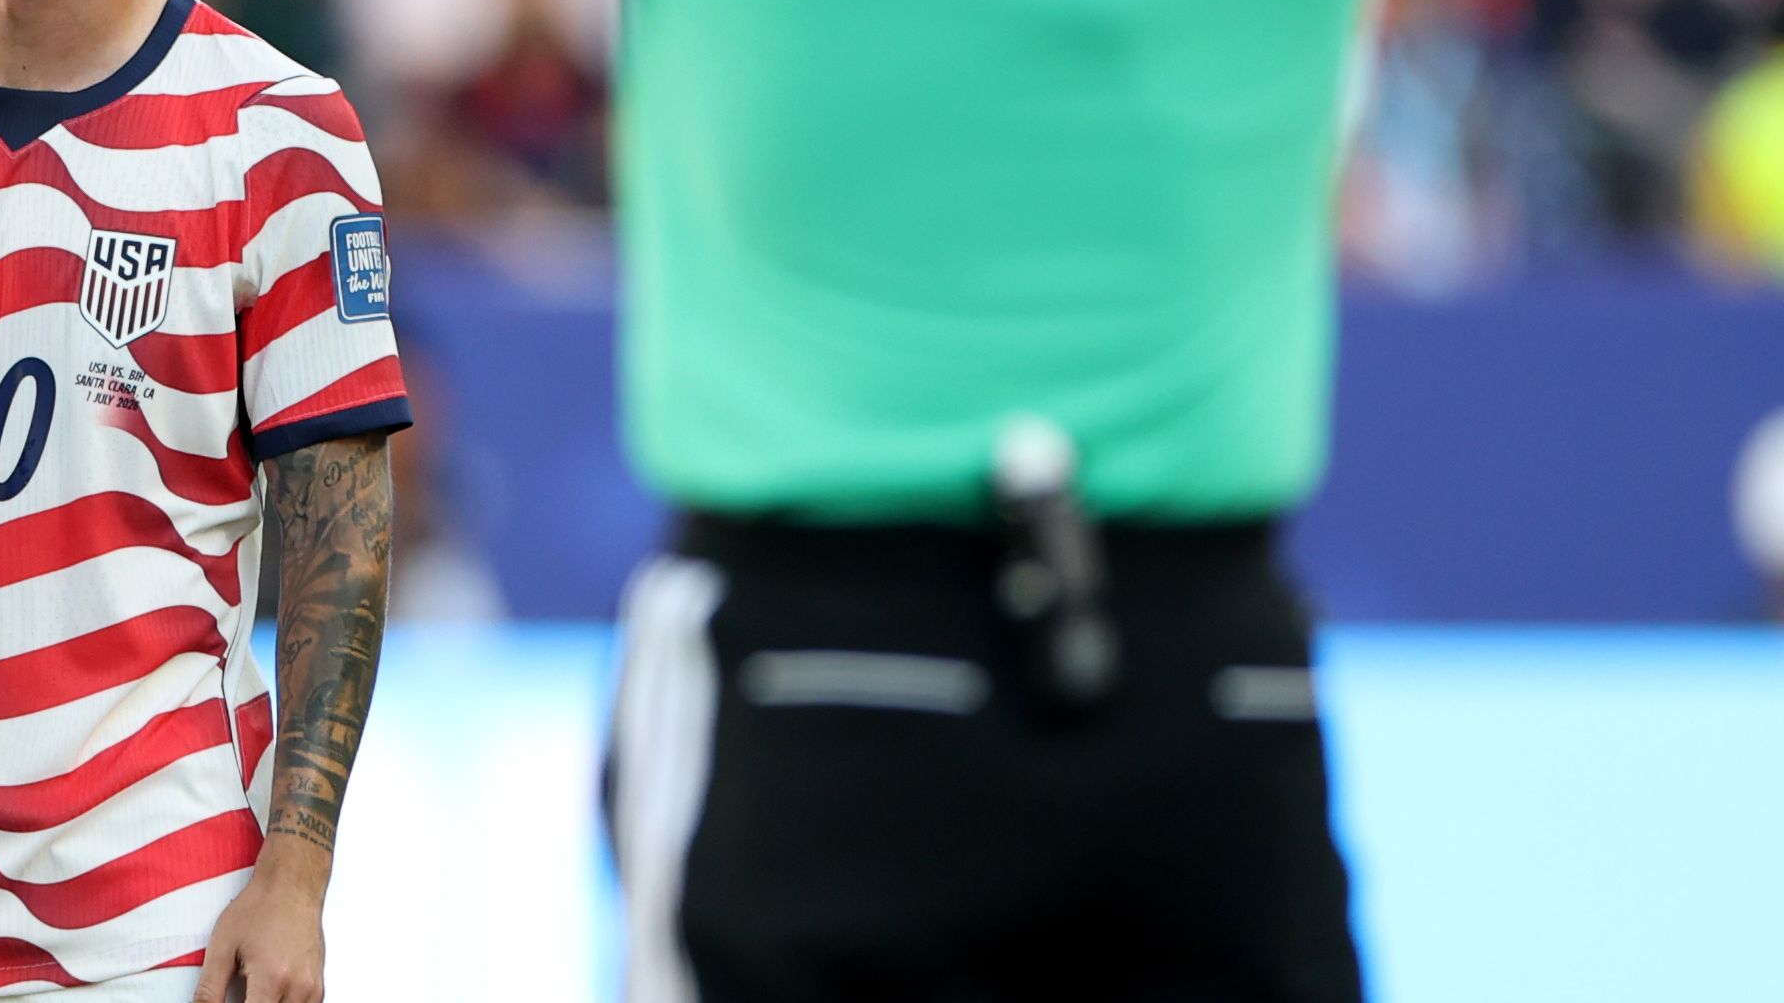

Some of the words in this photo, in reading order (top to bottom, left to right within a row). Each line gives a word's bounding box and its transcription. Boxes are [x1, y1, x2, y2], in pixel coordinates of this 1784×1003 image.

[94, 236, 169, 281] USA
[346, 273, 370, 293] the
[88, 362, 107, 375] USA
[111, 365, 124, 378] VS.
[128, 369, 146, 382] BIH
[75, 374, 105, 388] SANTA
[108, 380, 139, 397] CLARA,
[143, 387, 155, 399] CA
[93, 392, 115, 406] JULY
[116, 397, 140, 410] 2026
